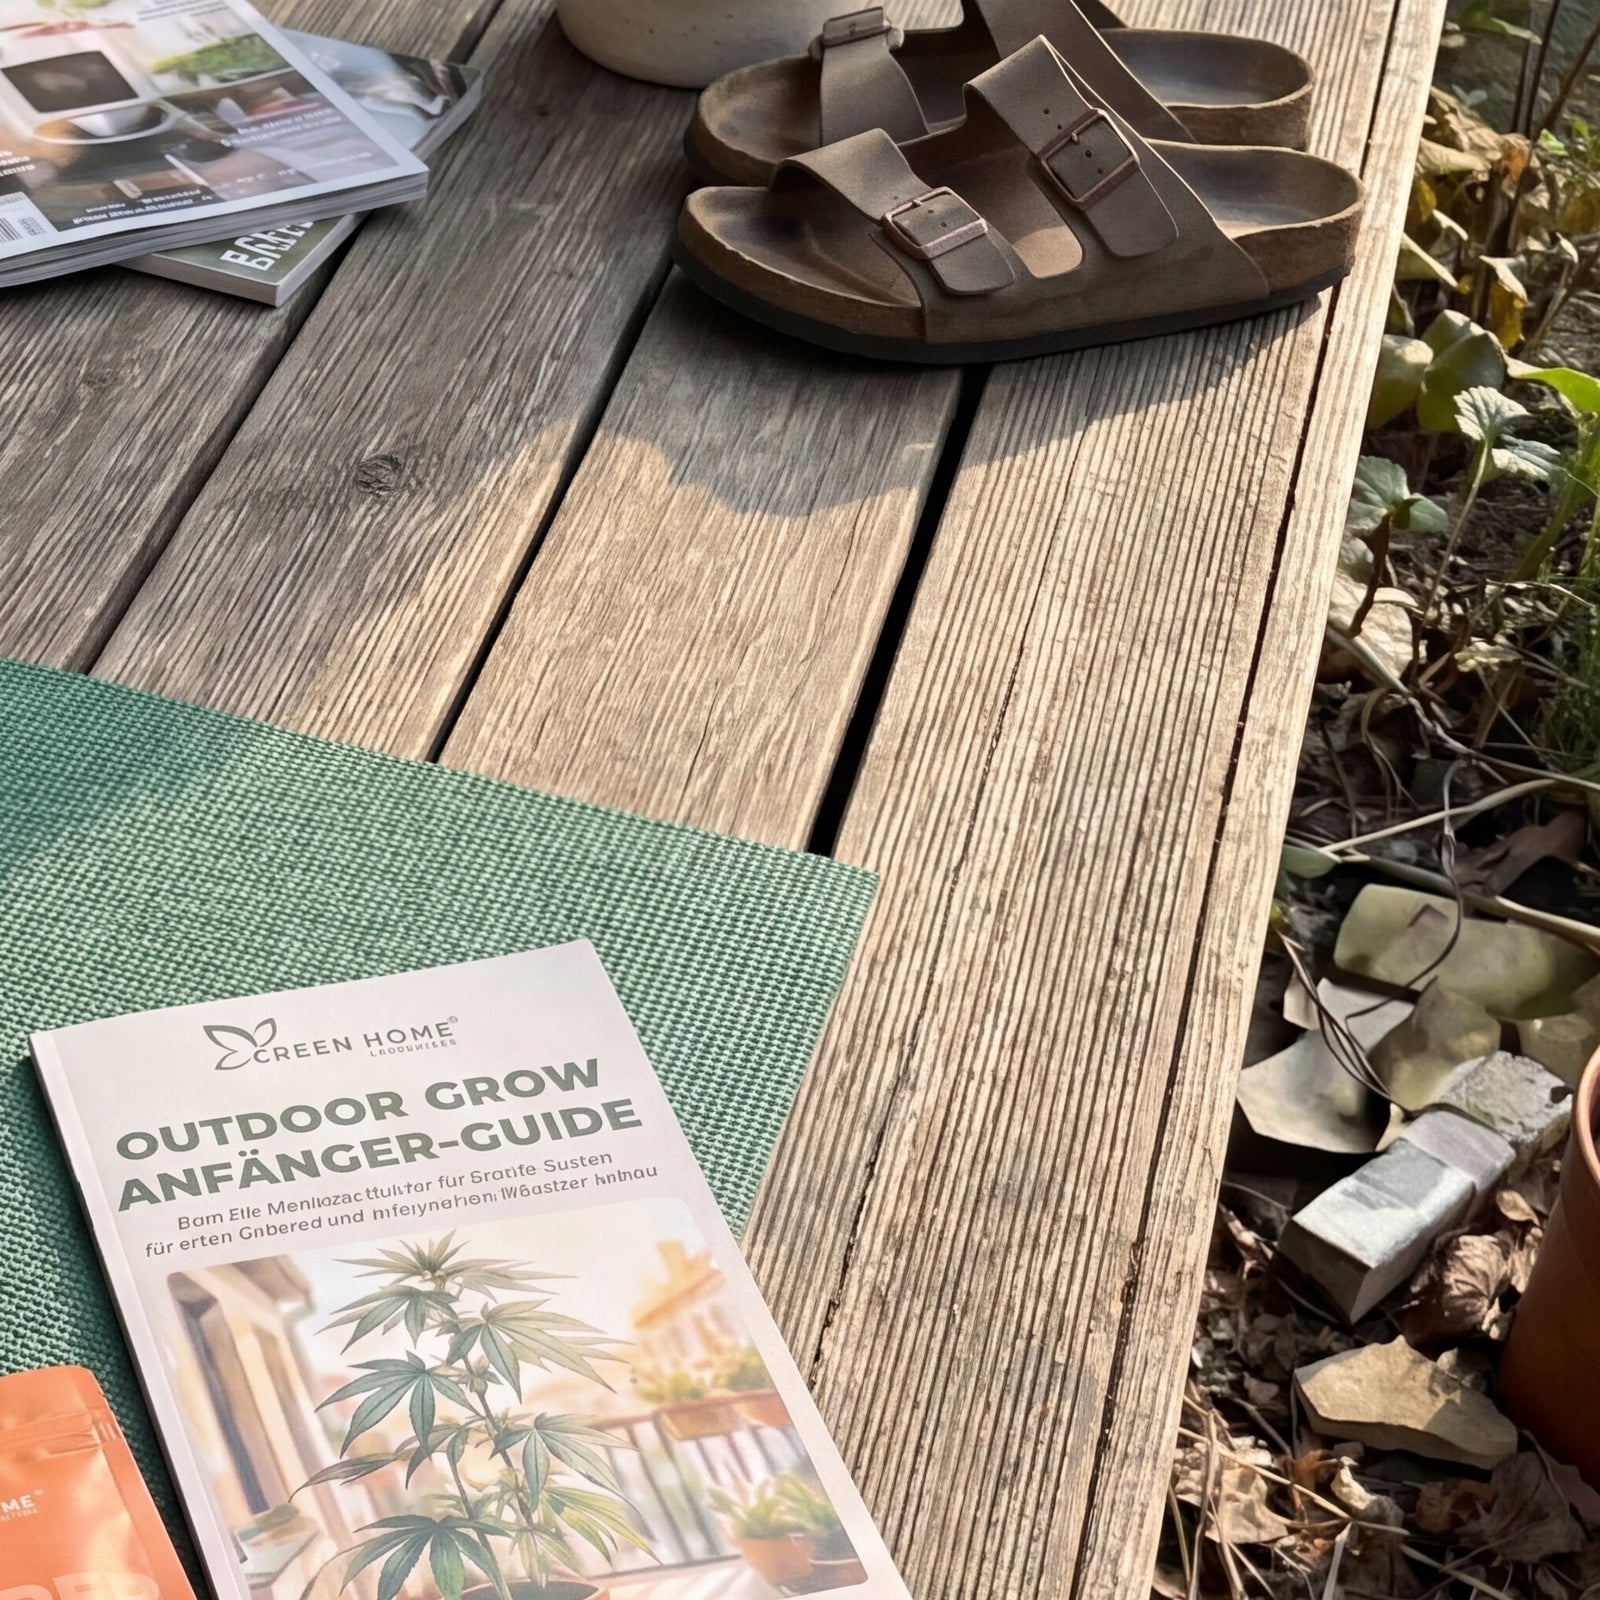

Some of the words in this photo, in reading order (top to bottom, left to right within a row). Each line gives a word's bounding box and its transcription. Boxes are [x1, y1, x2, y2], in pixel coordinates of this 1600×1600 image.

[363, 1021, 454, 1048] HOME
[115, 1090, 410, 1161] OUTDOOR
[425, 1058, 601, 1111] GROW
[117, 1097, 644, 1213] ANFÄNGER-GUIDE
[543, 1152, 614, 1174] Susten
[145, 1240, 175, 1258] für
[180, 1229, 233, 1251] erten
[327, 1208, 366, 1228] und
